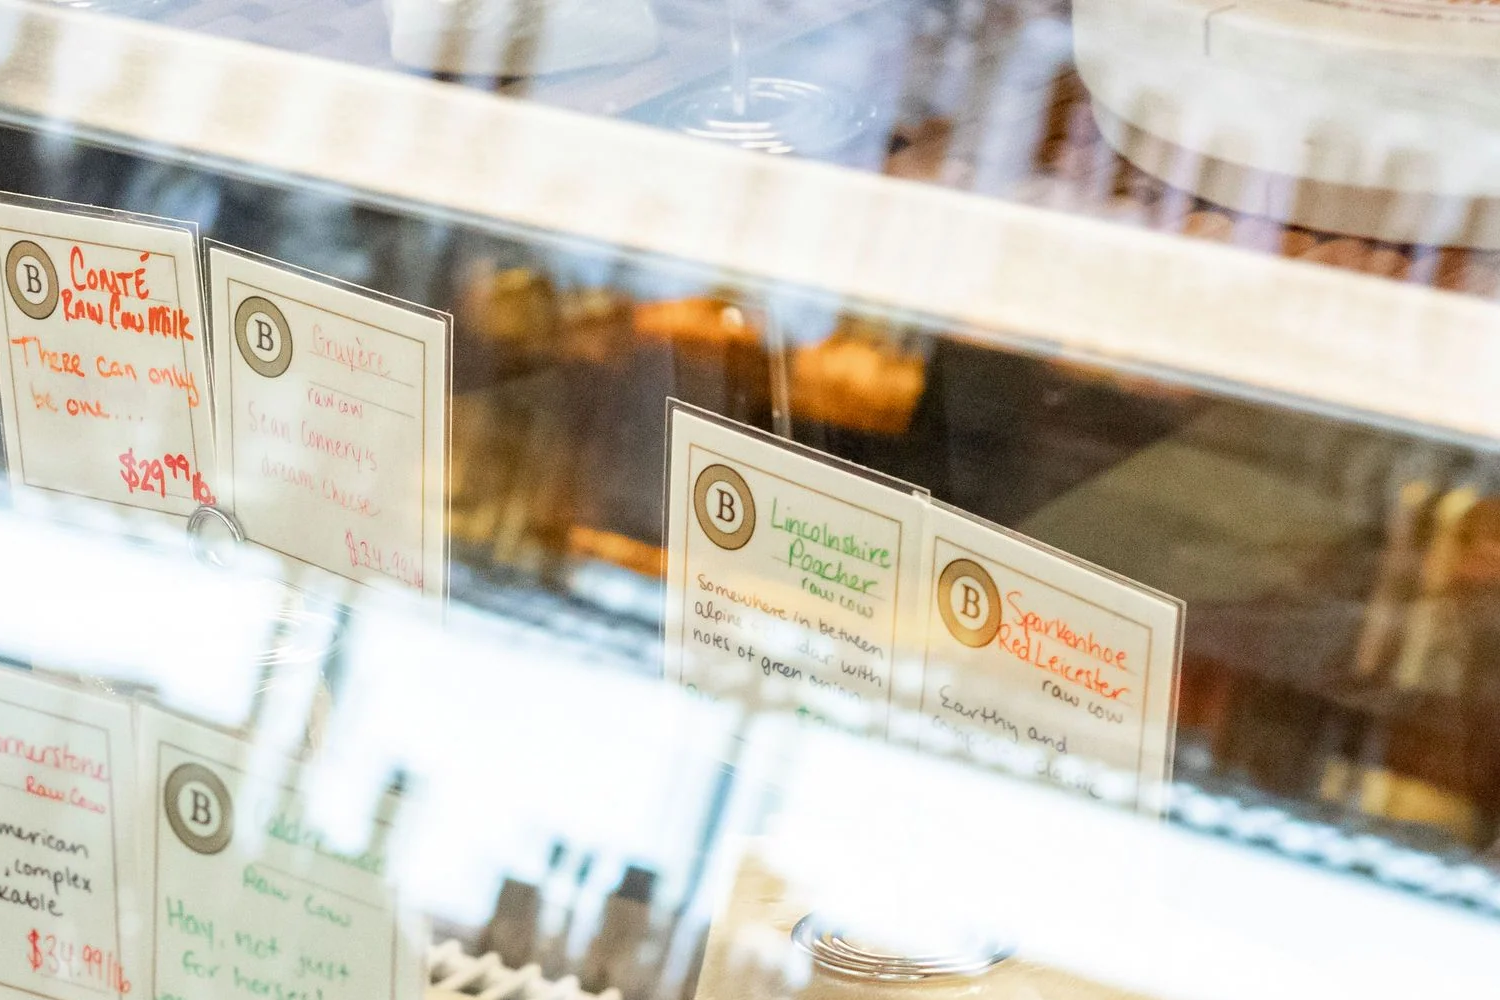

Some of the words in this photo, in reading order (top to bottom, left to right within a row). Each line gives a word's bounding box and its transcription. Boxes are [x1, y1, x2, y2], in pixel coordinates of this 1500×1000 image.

[23, 263, 42, 294] B
[255, 320, 274, 351] B
[310, 323, 392, 377] Gruyère
[30, 382, 58, 413] be
[96, 355, 137, 381] can
[148, 364, 200, 408] only
[307, 388, 335, 407] raw
[338, 402, 364, 419] cow
[248, 401, 292, 443] Sean
[301, 420, 378, 472] Connery's
[261, 453, 314, 490] dream
[716, 489, 735, 522] B
[770, 497, 892, 569] Lincolnshire
[788, 539, 878, 595] Poacher
[697, 573, 788, 620] Somewhere
[793, 611, 811, 629] in
[818, 617, 884, 660] between
[802, 577, 834, 603] raw
[839, 595, 874, 619] cow
[960, 583, 980, 619] B
[1005, 590, 1128, 672] Sparkenhoe
[693, 626, 731, 652] notes
[737, 646, 755, 662] of
[760, 656, 802, 681] green
[1033, 640, 1132, 702] Leicester
[840, 659, 882, 688] with
[938, 684, 1019, 743] Earthy
[1027, 726, 1069, 754] and
[1042, 679, 1080, 706] raw
[1087, 704, 1124, 725] cow
[26, 775, 65, 803] Raw
[190, 788, 212, 825] B
[14, 858, 93, 895] complex
[234, 930, 279, 959] not
